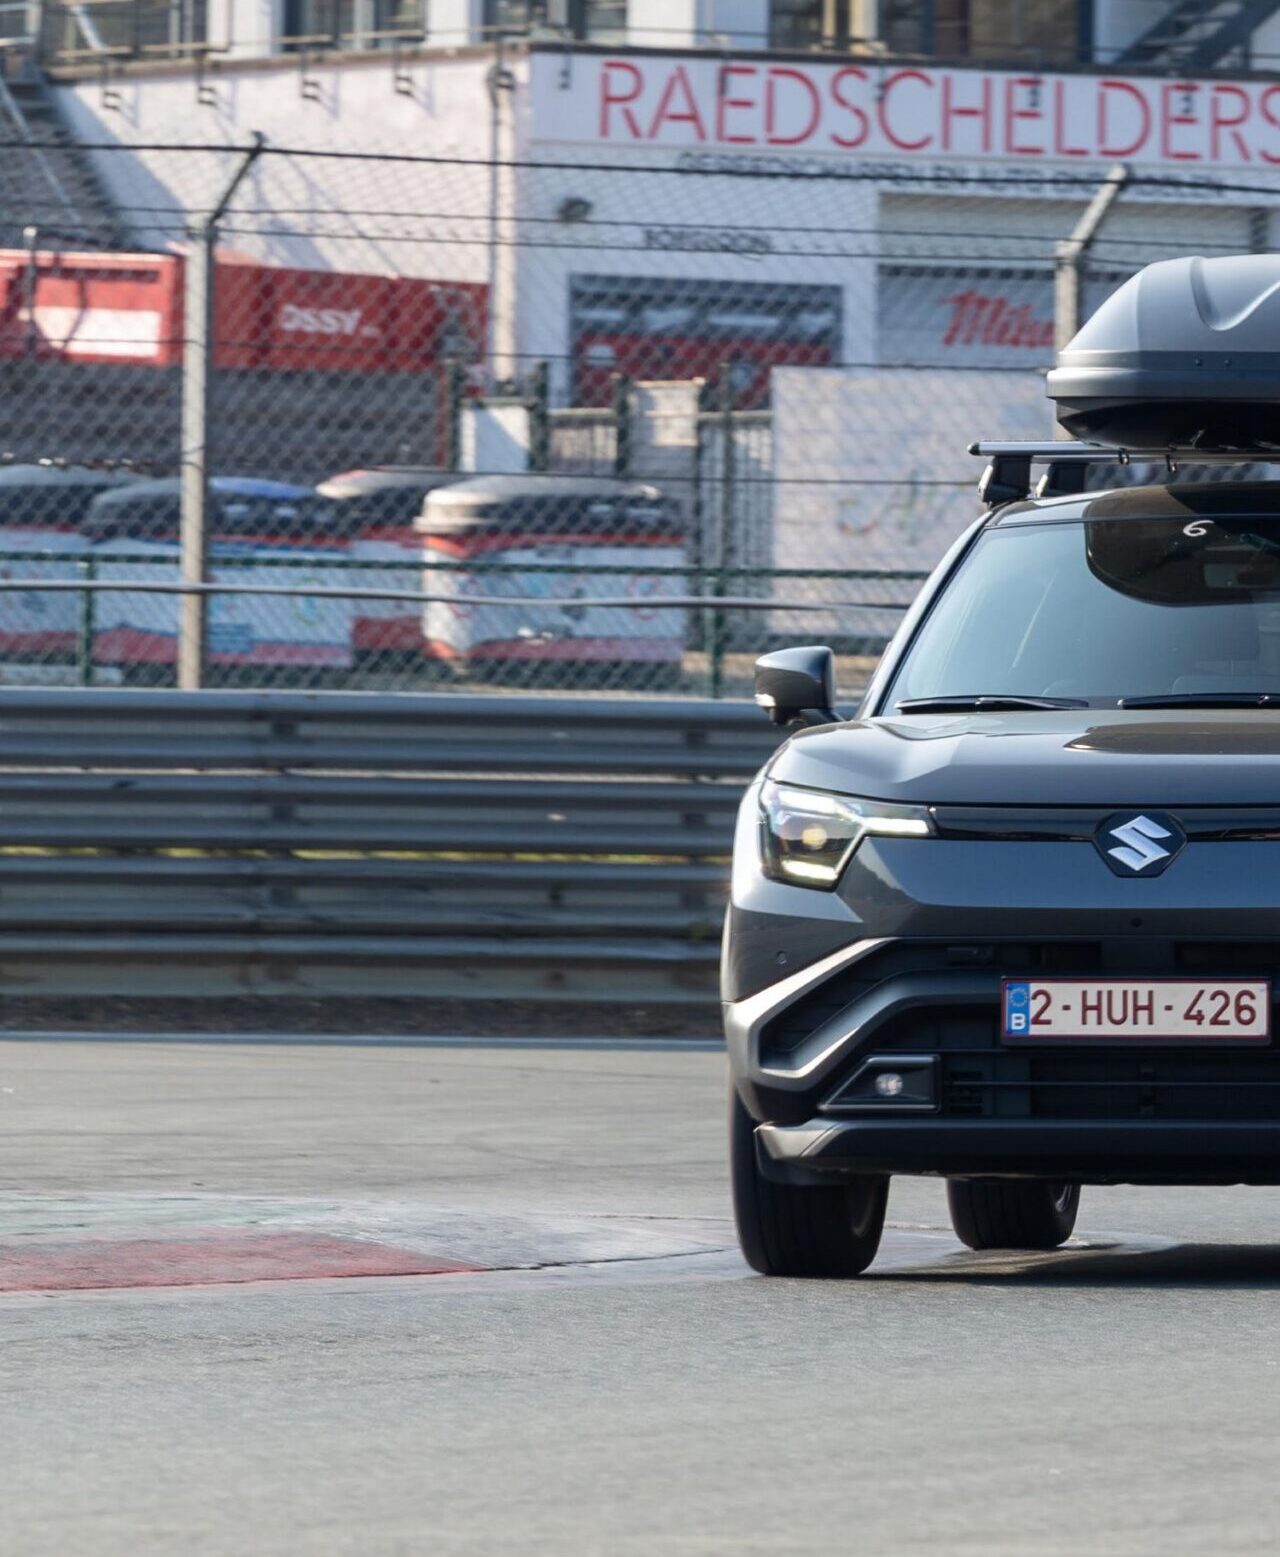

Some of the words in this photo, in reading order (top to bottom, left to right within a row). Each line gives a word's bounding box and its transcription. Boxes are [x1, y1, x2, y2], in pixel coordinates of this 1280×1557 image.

[1182, 519, 1215, 537] 6
[1030, 989, 1257, 1026] 2-HUH-426
[1010, 1013, 1026, 1030] B
